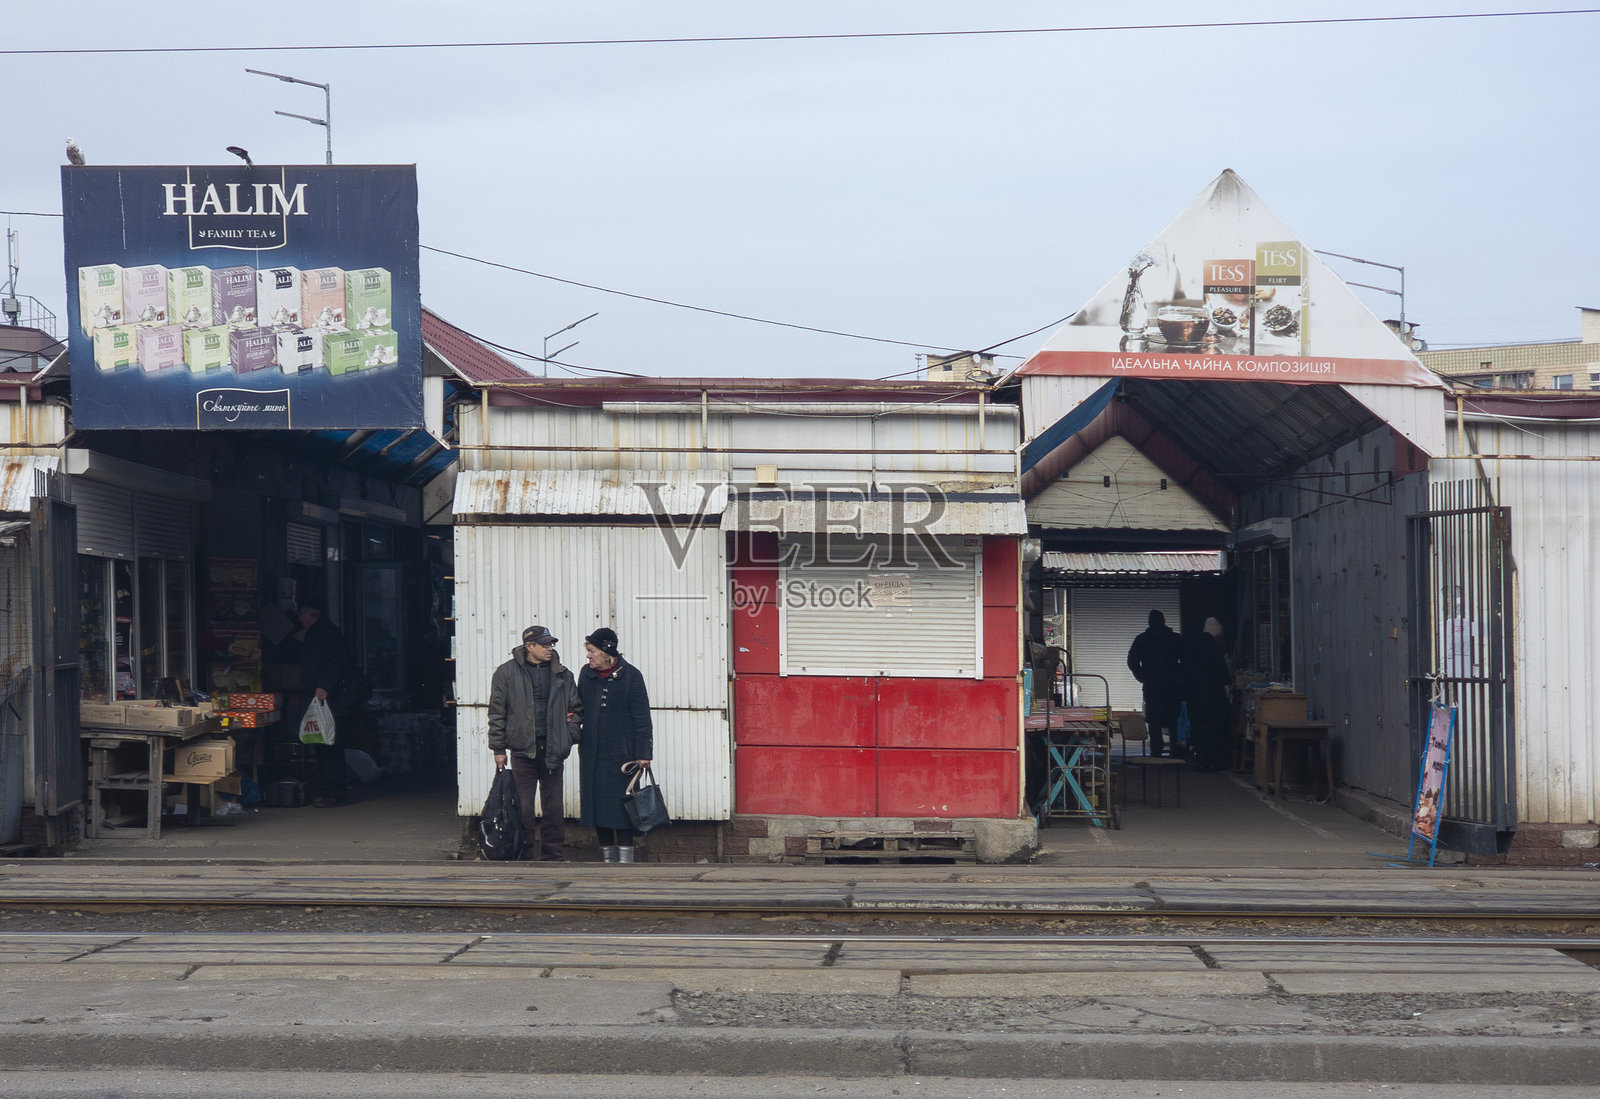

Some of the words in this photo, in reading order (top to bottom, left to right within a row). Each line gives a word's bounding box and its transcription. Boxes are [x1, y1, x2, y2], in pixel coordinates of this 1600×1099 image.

[162, 183, 309, 216] HALIM
[207, 229, 244, 239] FAMILY
[247, 229, 268, 239] TEA
[1261, 249, 1297, 267] TESS
[226, 274, 252, 284] HALIM
[1208, 264, 1245, 282] TESS
[245, 337, 270, 347] HALIM
[1111, 358, 1180, 371] ІДЕАЛЬНА
[1184, 358, 1232, 372] ЧАЙНА
[1237, 361, 1337, 375] КОМПОЗИЦІЯ!
